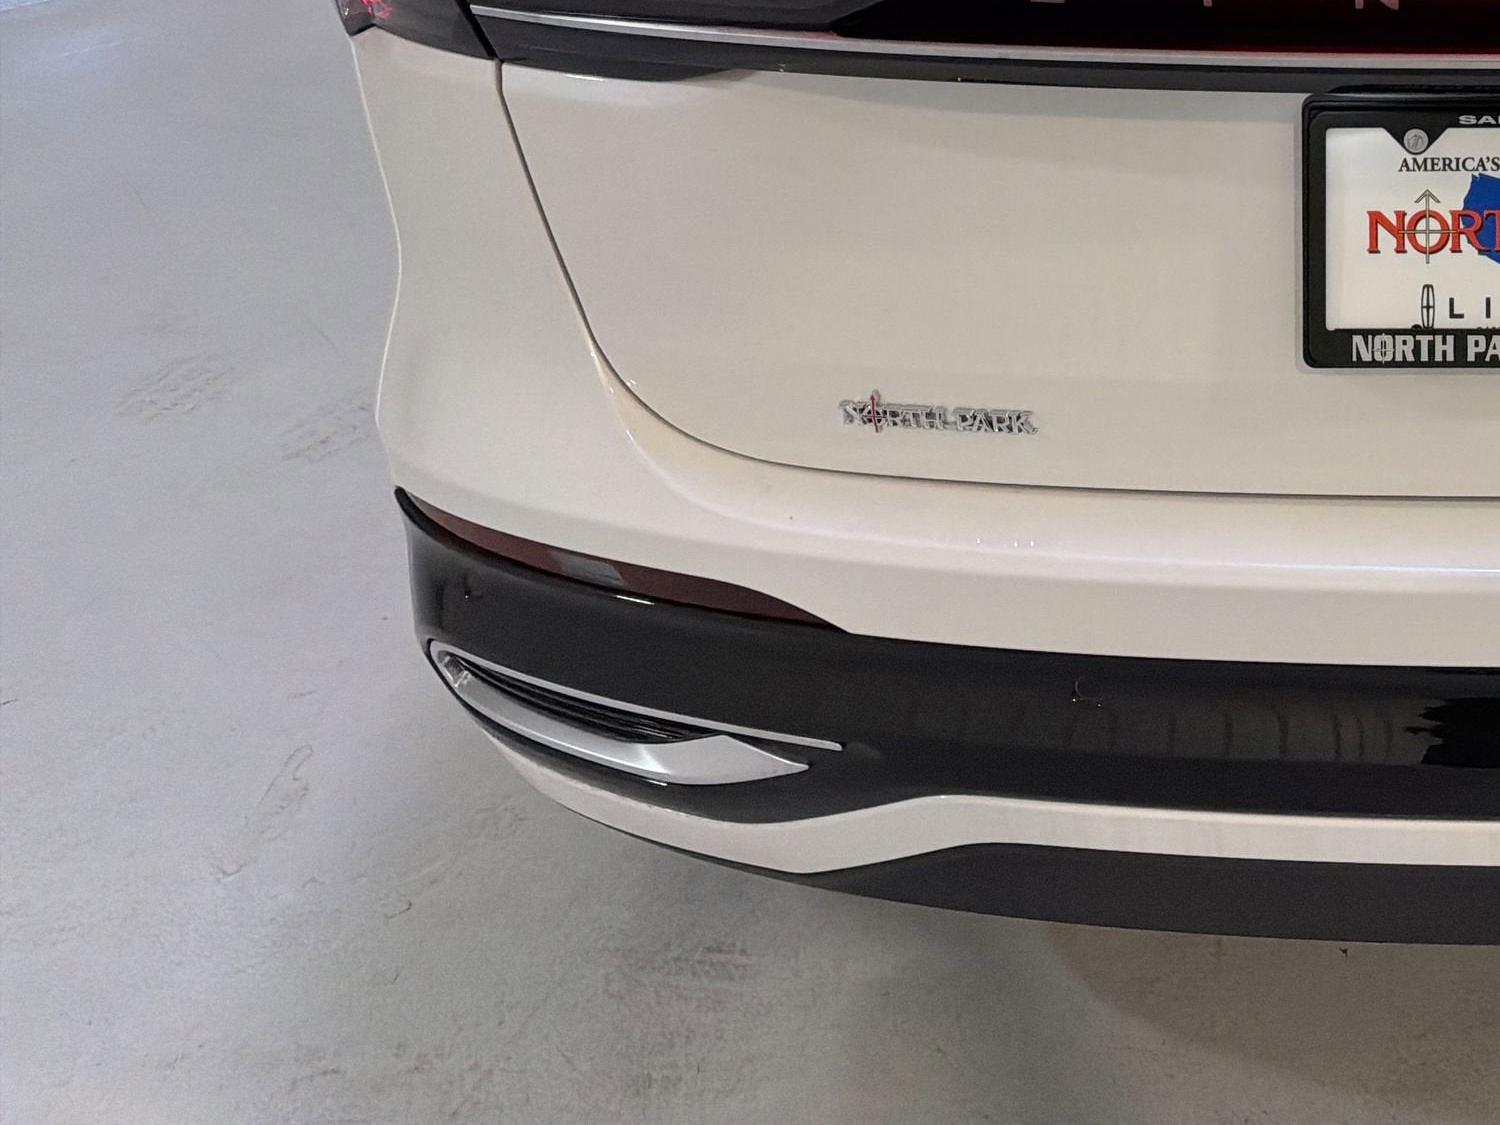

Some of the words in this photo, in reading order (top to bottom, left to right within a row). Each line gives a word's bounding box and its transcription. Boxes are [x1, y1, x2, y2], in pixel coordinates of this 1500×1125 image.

[1398, 157, 1500, 172] AMERICA'S
[1351, 334, 1456, 362] NORTH
[840, 401, 948, 431] NORTH
[953, 408, 1039, 435] PARK
